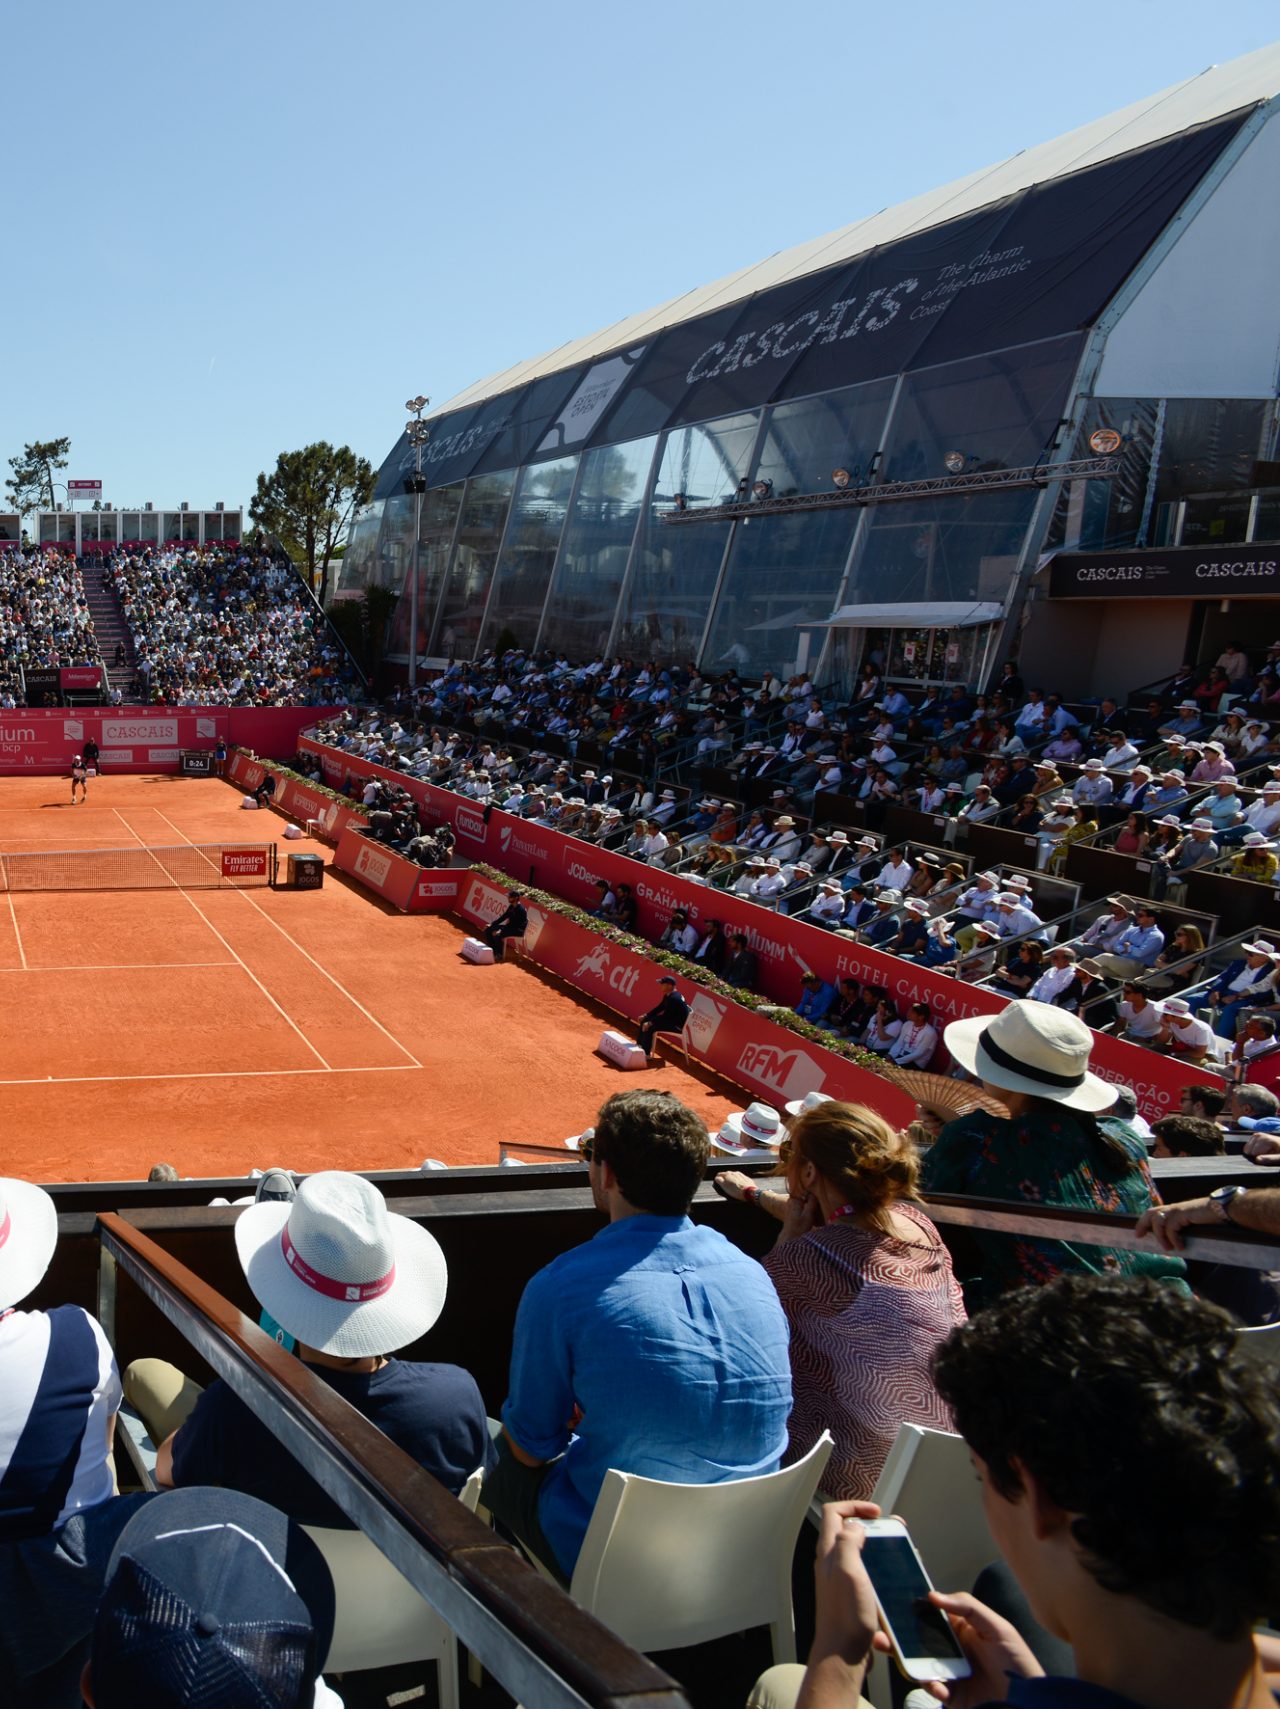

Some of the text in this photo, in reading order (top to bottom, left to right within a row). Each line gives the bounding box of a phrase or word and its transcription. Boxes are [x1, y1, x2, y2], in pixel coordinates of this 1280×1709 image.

[937, 246, 1024, 281] The Charm
[960, 257, 1031, 289] Atlantic
[910, 299, 951, 321] Coast
[686, 278, 919, 384] CASCAIS
[1076, 567, 1143, 581] CASCAIS
[1195, 561, 1277, 577] CASCAIS
[106, 726, 174, 739] CASCAIS
[2, 743, 21, 754] bcp
[458, 814, 482, 835] funbox
[224, 855, 265, 865] Emirates
[230, 864, 258, 873] FLY BETTER
[369, 858, 387, 876] JOGOS
[299, 876, 320, 884] JOGOS
[482, 894, 508, 917] JOGOS
[636, 883, 699, 919] GRAHAM'S
[744, 925, 786, 962] MUMM
[609, 964, 640, 998] ctt
[835, 955, 889, 989] HOTEL
[896, 979, 981, 1018] CASCAIS
[739, 1046, 799, 1089] RFM
